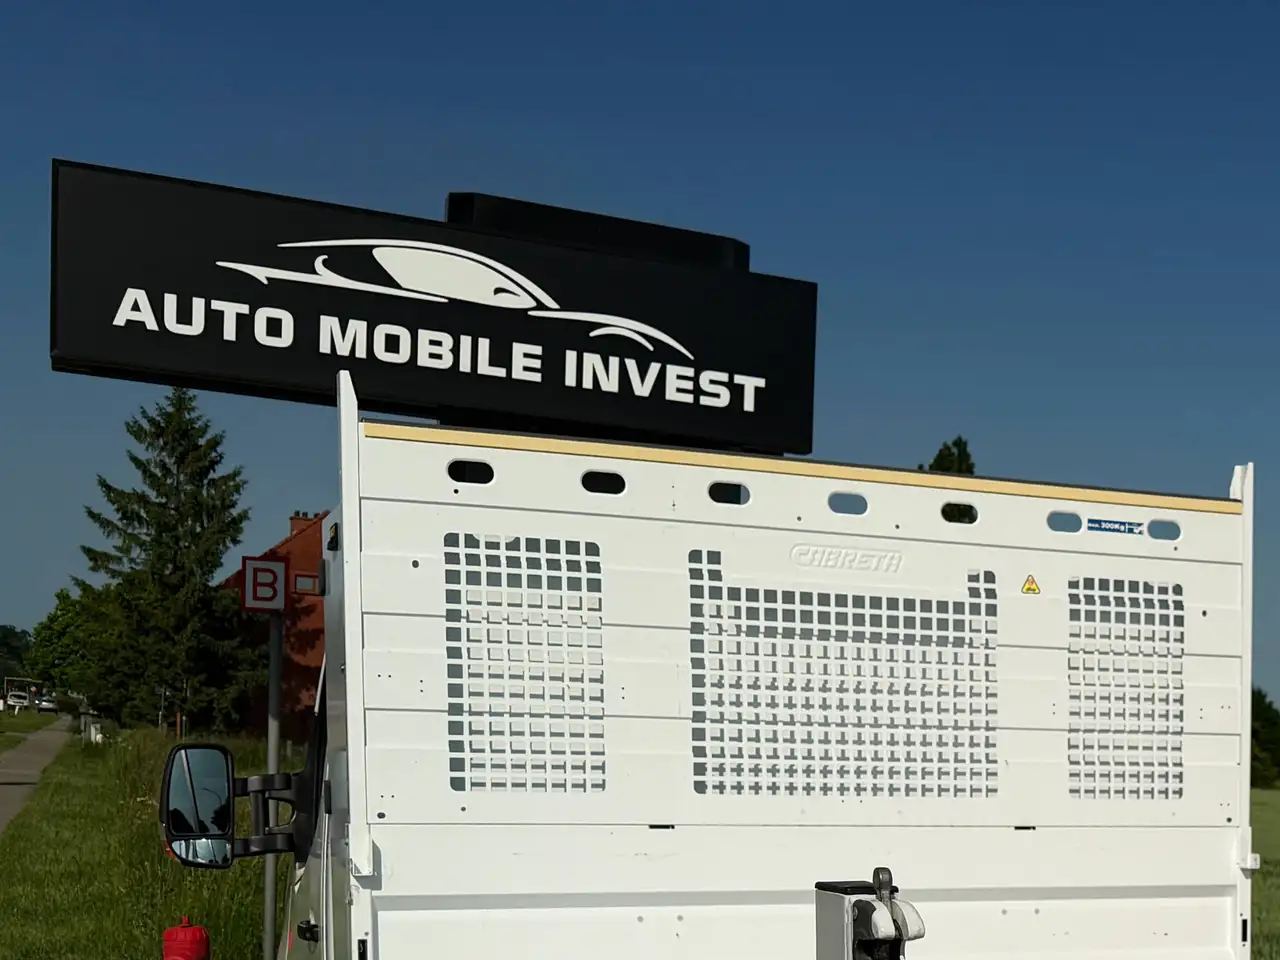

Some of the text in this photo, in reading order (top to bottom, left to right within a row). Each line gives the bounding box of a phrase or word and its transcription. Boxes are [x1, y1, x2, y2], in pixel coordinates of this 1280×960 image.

[112, 287, 766, 412] AUTO MOBILE INVEST
[790, 543, 904, 573] CABRETA
[252, 567, 278, 602] B
